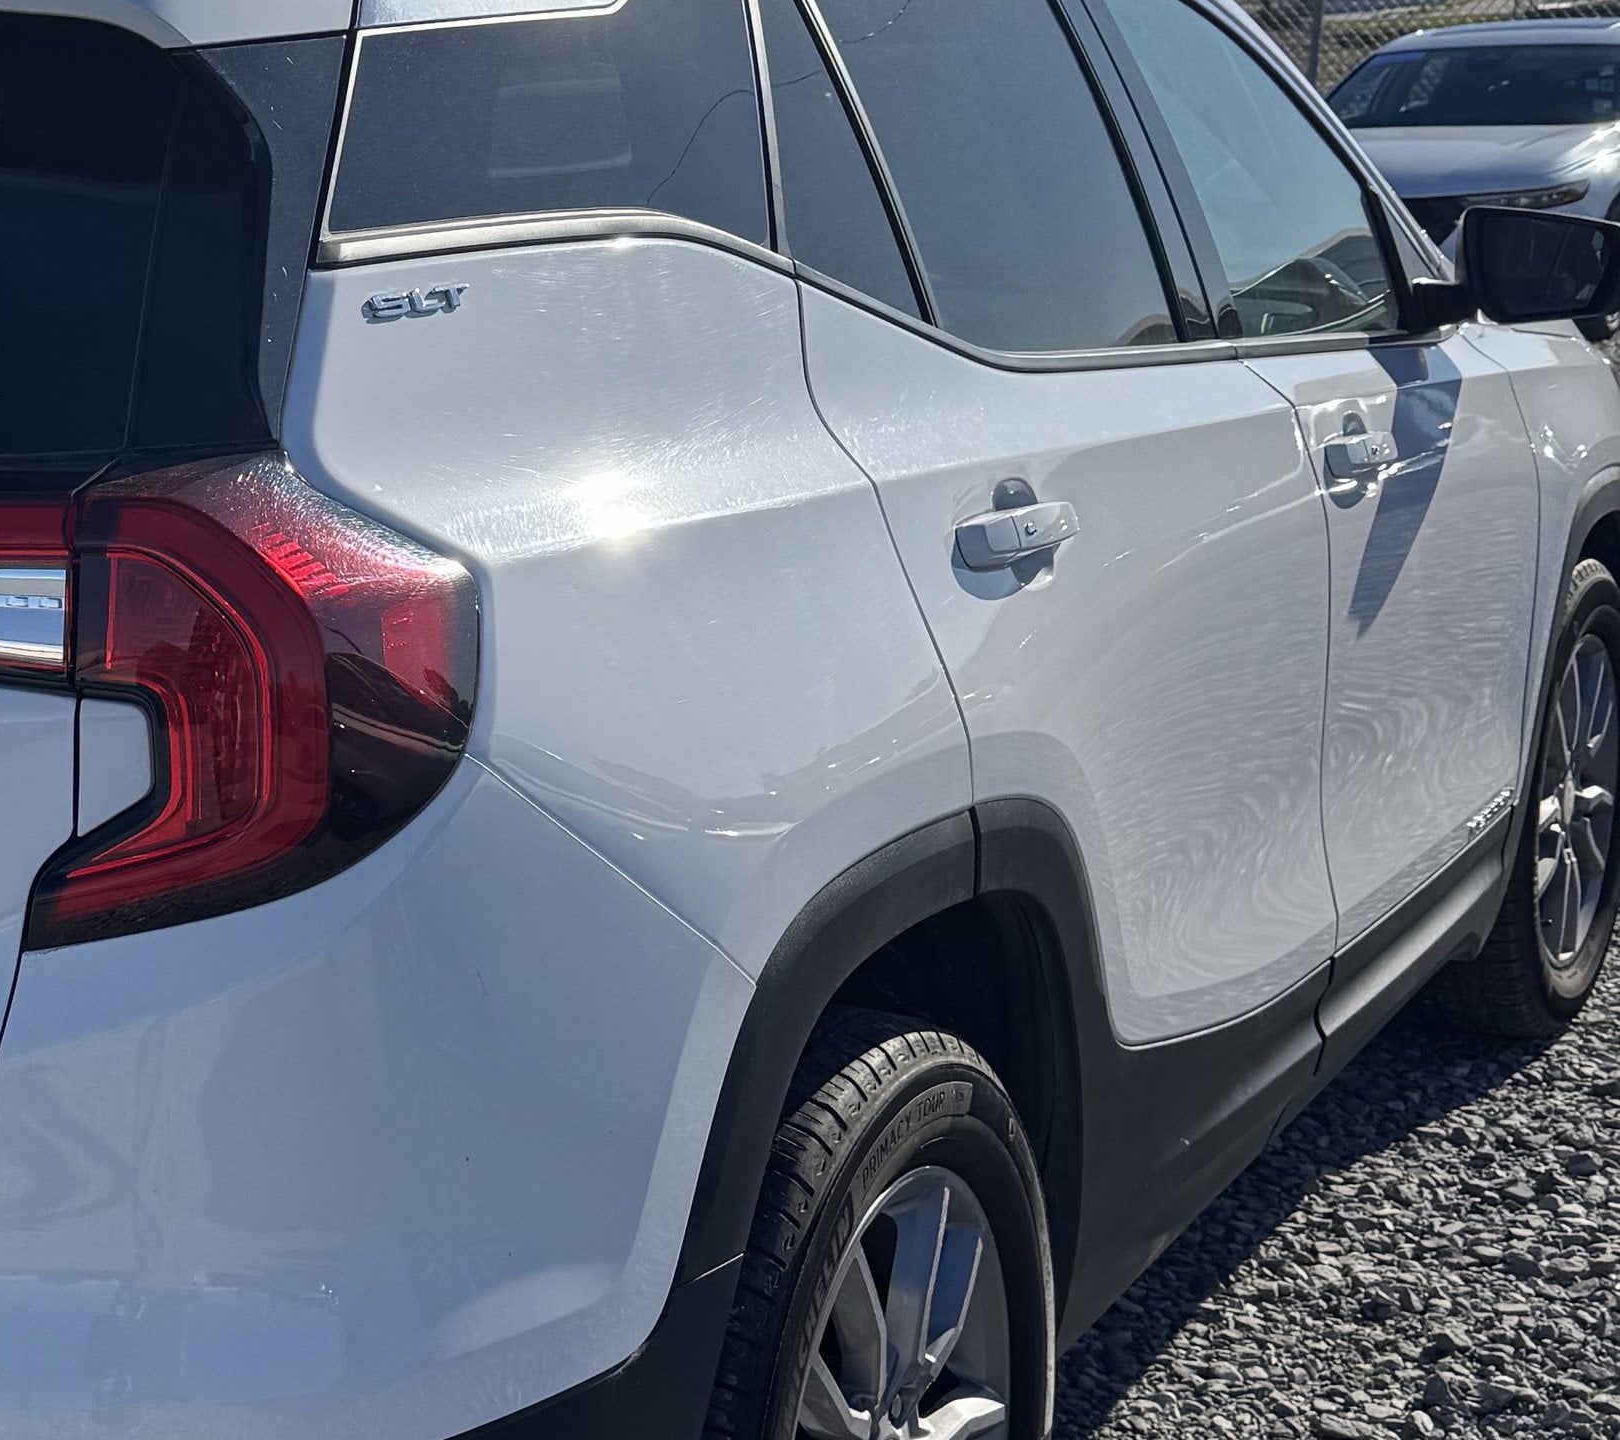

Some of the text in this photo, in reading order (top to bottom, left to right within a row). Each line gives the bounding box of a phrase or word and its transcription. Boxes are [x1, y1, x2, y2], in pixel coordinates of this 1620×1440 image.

[364, 282, 470, 323] SLT
[862, 1091, 945, 1190] PRIMACY TOUR
